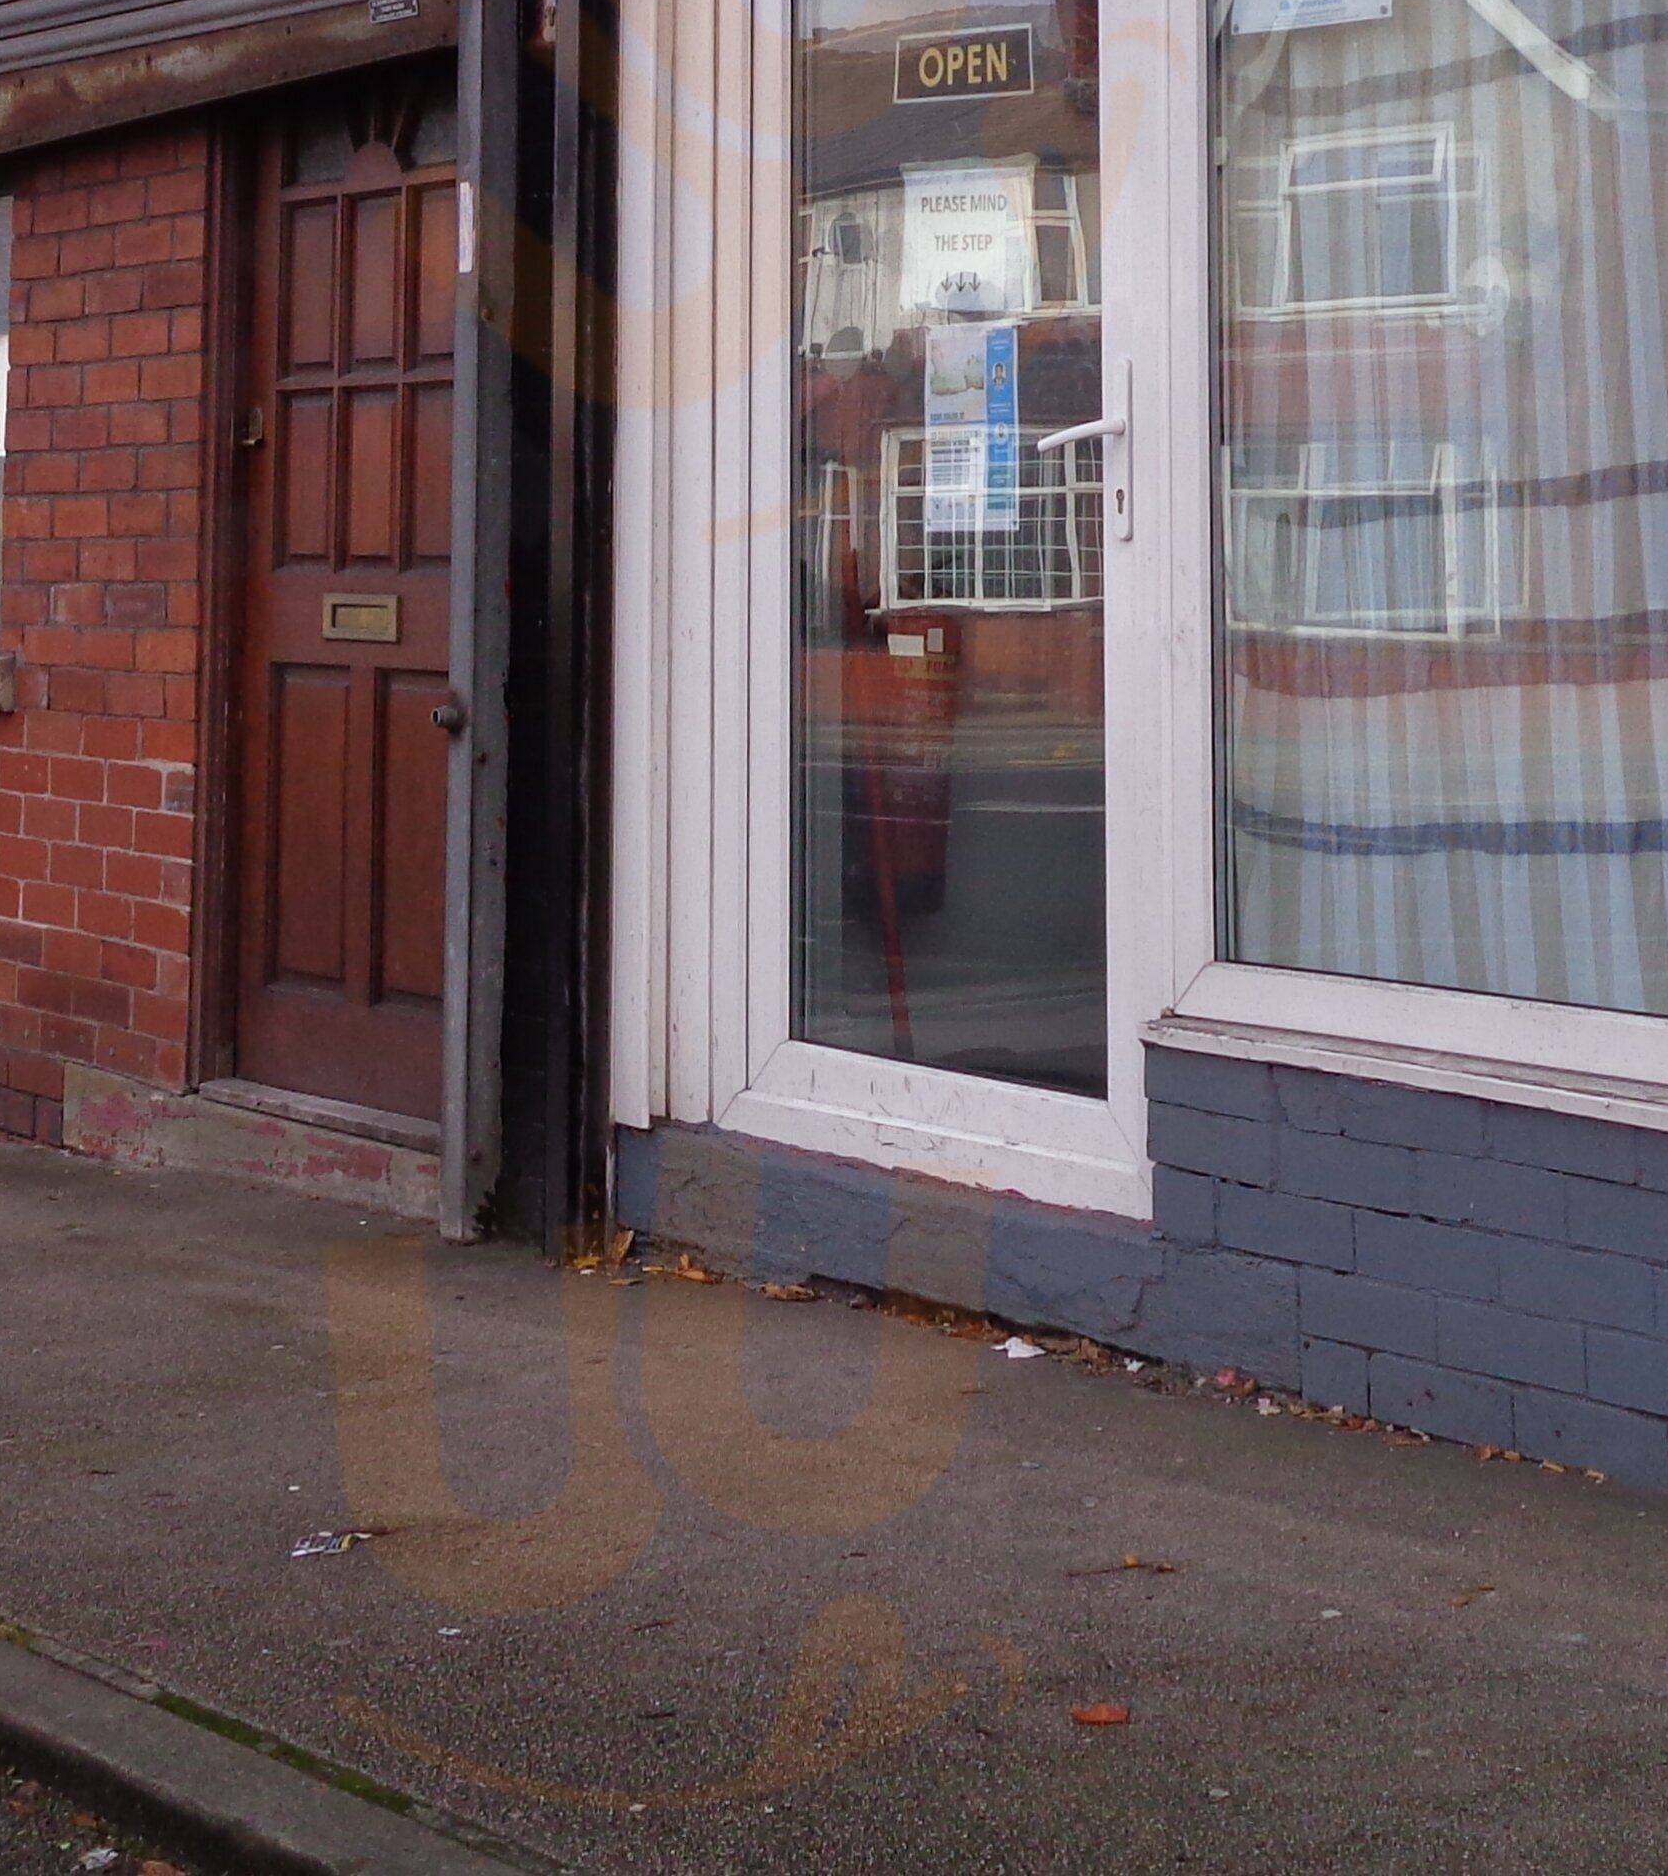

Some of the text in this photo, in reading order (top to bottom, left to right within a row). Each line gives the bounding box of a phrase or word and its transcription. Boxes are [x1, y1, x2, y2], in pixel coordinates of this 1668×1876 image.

[919, 42, 1008, 88] OPEN
[921, 193, 1007, 214] PLEASE MIND
[934, 233, 992, 252] THE STEP
